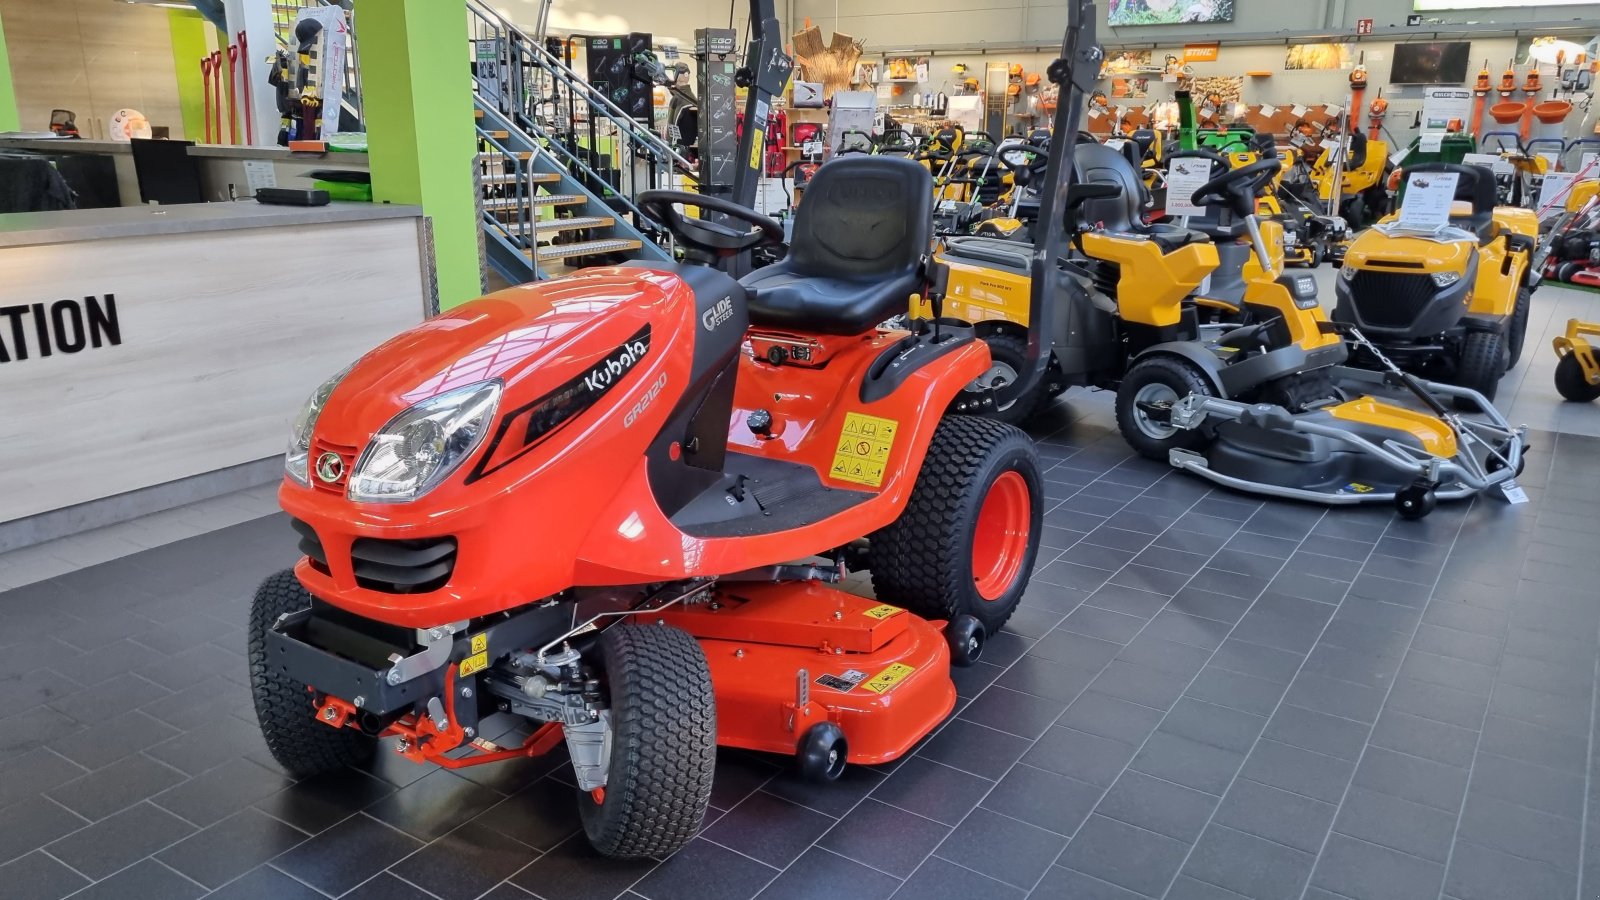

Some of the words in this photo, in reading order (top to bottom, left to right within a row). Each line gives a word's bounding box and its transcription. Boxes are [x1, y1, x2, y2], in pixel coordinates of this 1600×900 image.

[0, 293, 121, 364] TION
[702, 295, 732, 331] GLIDE
[715, 308, 734, 326] STEER
[584, 341, 647, 391] Kubota
[623, 371, 667, 428] GR2120
